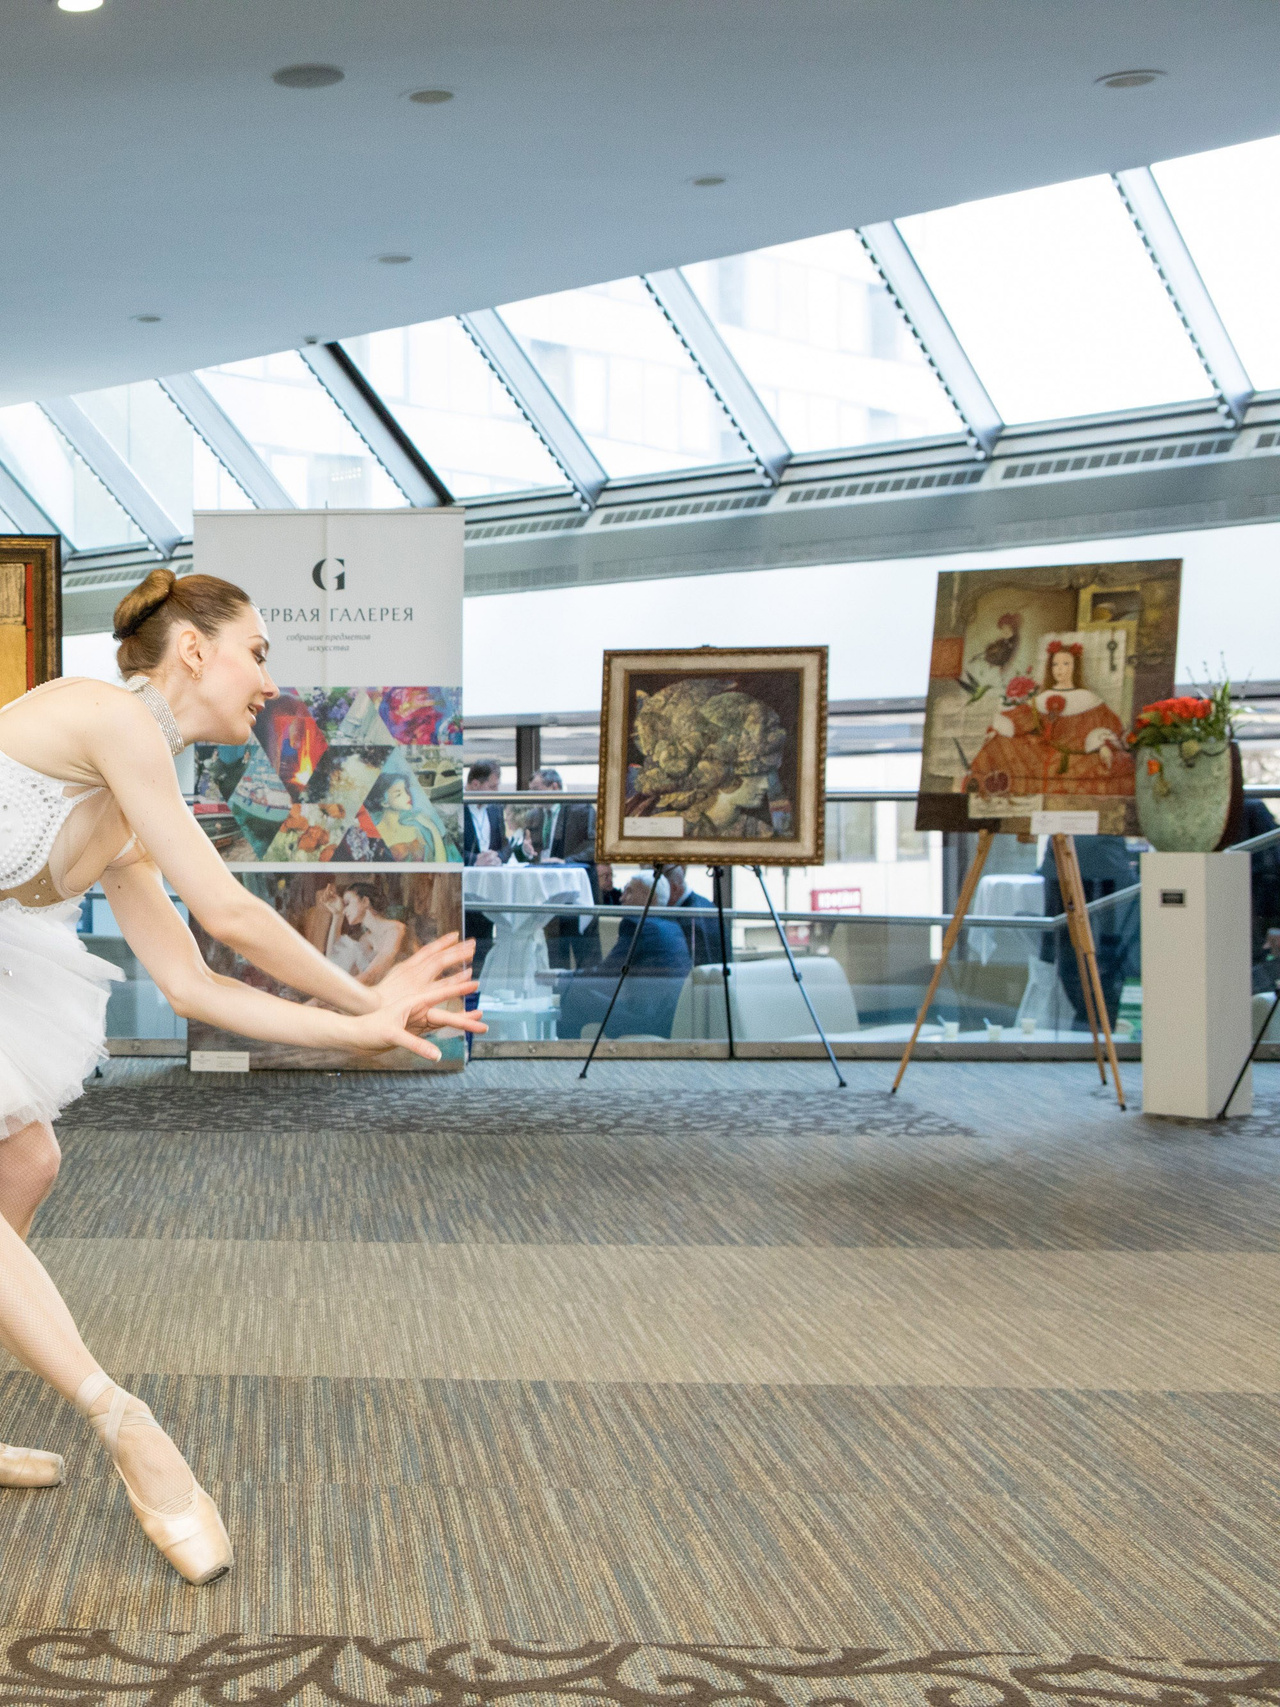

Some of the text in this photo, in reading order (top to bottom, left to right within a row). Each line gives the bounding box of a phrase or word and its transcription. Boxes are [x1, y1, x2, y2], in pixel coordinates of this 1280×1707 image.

[312, 558, 345, 591] G
[259, 607, 414, 622] ЕРВАЯ ГАЛЕРЕЯ
[286, 632, 371, 642] собрание предметов
[307, 645, 350, 653] искусства
